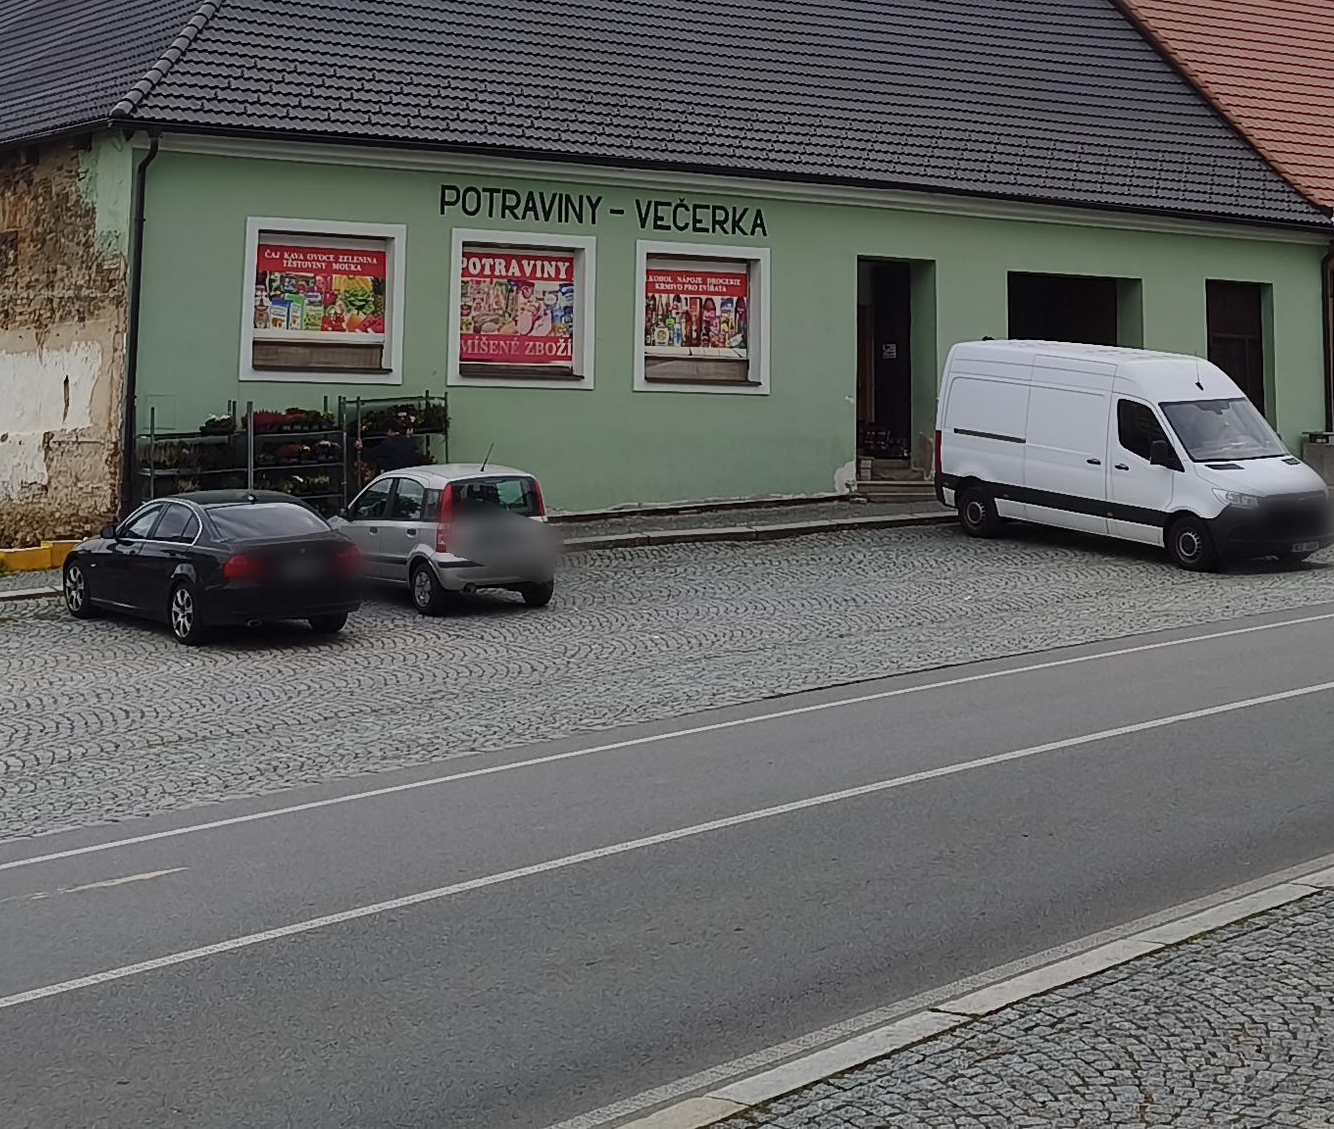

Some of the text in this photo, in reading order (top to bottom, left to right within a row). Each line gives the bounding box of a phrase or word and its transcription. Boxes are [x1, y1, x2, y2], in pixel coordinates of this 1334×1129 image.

[440, 184, 603, 226] POTRAVINY
[635, 197, 768, 238] VEČERKA
[264, 249, 280, 259] ČAJ
[307, 253, 335, 262] OVOCE
[339, 255, 378, 265] ZELENINA
[282, 259, 362, 271] TĚSTOVINY MOUKA
[461, 257, 570, 279] POTRAVINY
[677, 274, 703, 284] NÁPOJE
[655, 283, 683, 291] KRMIVO
[684, 284, 698, 292] PRO
[524, 338, 572, 357] ZBOŽÍ
